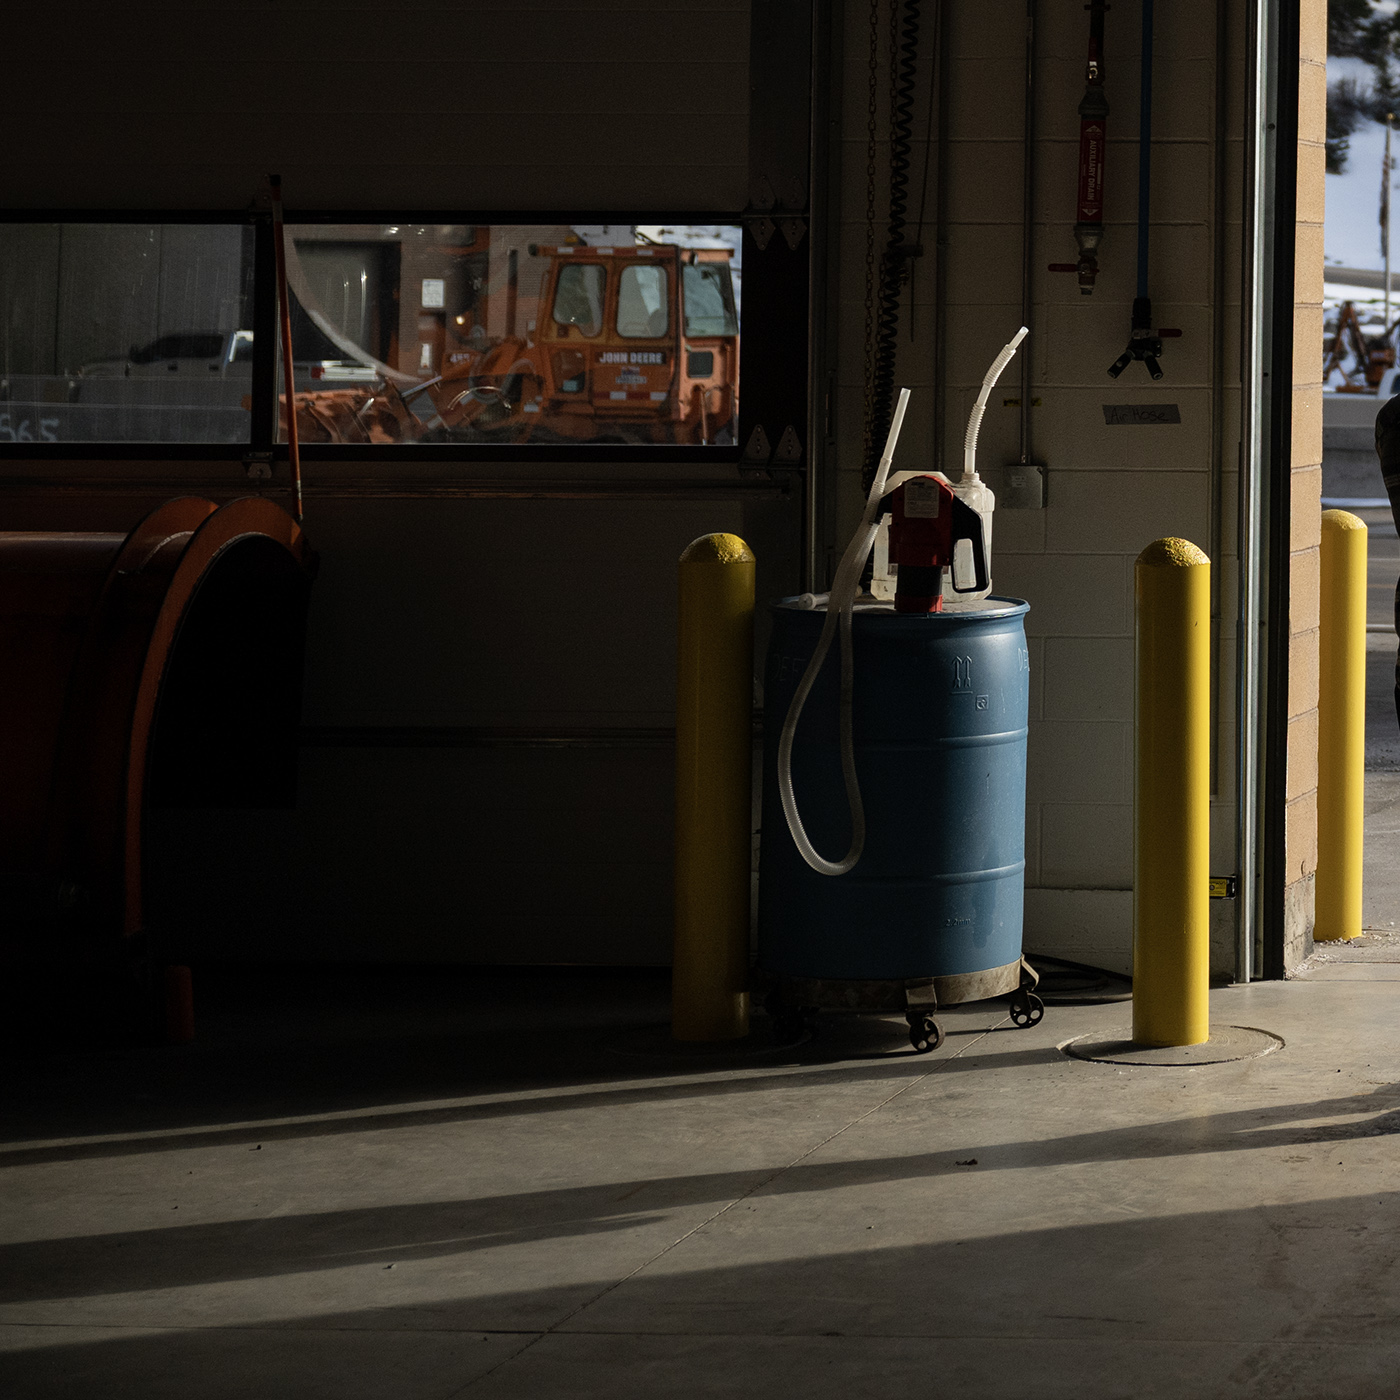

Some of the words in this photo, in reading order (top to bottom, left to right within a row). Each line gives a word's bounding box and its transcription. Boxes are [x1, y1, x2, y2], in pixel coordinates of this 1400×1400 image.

[1088, 139, 1097, 177] AUXILIARY
[1087, 177, 1096, 201] DRAIN
[599, 352, 628, 364] JOHN
[630, 352, 663, 364] DEERE
[1131, 407, 1169, 422] Hose
